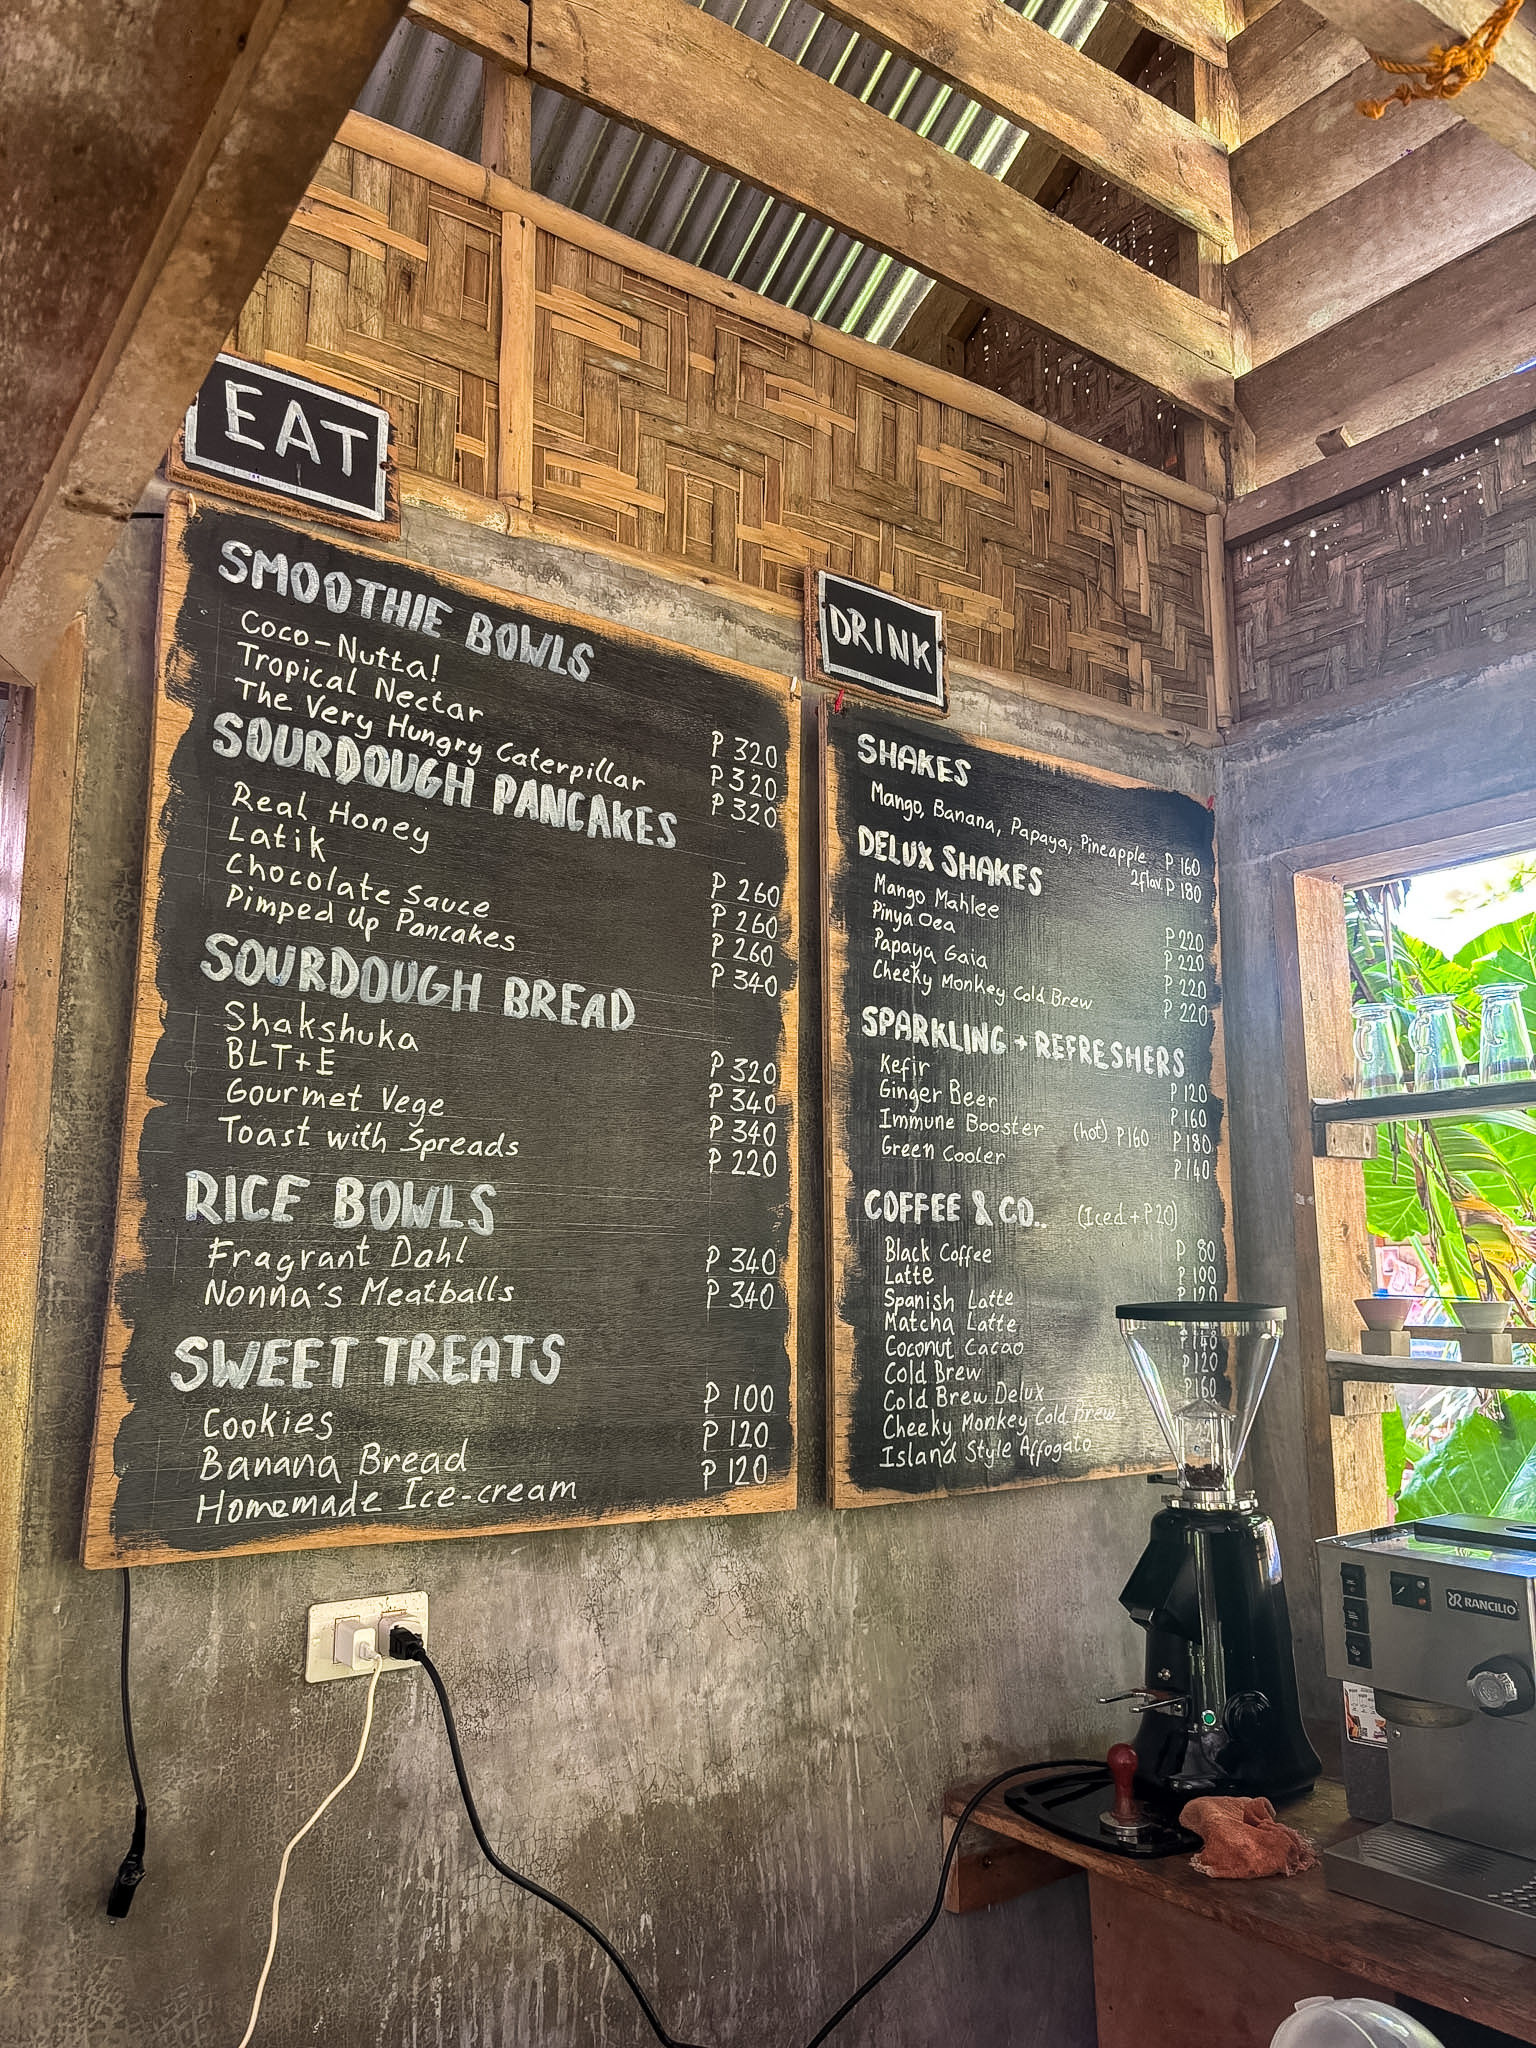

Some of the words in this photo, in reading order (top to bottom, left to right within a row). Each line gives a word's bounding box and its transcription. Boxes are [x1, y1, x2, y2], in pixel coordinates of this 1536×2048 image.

[225, 380, 368, 476] EAT
[219, 540, 453, 638] SMOOTHIE
[465, 612, 595, 682] BOWLS
[829, 604, 933, 674] DRINK
[237, 642, 357, 695] Tropical
[375, 677, 484, 721] Nectar
[234, 677, 292, 711] The
[307, 695, 373, 739] Very
[388, 714, 483, 766] Hungry
[497, 743, 646, 792] Caterpillar
[735, 738, 778, 768] 320
[857, 733, 972, 787] SHAKES
[213, 712, 475, 807] SOURDOUGH
[492, 773, 678, 848] PANCAKES
[729, 768, 777, 800] 320
[231, 781, 307, 820] Real
[329, 801, 430, 854] Honey
[731, 799, 777, 828] 320
[871, 781, 924, 822] Mango,
[934, 799, 1000, 837] Banana,
[1011, 817, 1072, 854] Papaya,
[1081, 834, 1147, 868] Pineapple
[1181, 857, 1200, 876] 160
[229, 816, 326, 862] Latik
[858, 825, 934, 872] DELUX
[942, 845, 1043, 896] SHAKES
[226, 853, 391, 905] Chocolate
[404, 885, 490, 918] Sauce
[738, 880, 780, 907] 260
[874, 873, 925, 910] Mango
[935, 888, 999, 918] Mahlee
[1181, 883, 1201, 903] 180
[226, 884, 333, 924] Pimped
[348, 907, 379, 942] Up
[396, 909, 516, 952] Pancakes
[736, 910, 778, 938] 260
[872, 900, 913, 932] Pinya
[734, 939, 772, 967] 260
[874, 927, 936, 968] Papaya
[944, 945, 988, 969] Gaia
[1178, 930, 1203, 952] 220
[1178, 954, 1204, 972] 220
[200, 932, 482, 1012] SOURDOUGH
[504, 976, 635, 1031] BREAD
[734, 972, 778, 996] 340
[873, 959, 932, 996] Cheeky
[942, 974, 1005, 1006] Monkey
[1013, 986, 1045, 1005] Cold
[1051, 988, 1092, 1010] Brew
[1179, 979, 1206, 999] 220
[224, 1001, 418, 1051] Shakshuka
[1179, 1005, 1207, 1026] 220
[862, 1006, 1007, 1054] SPARKLING
[1035, 1030, 1185, 1078] REFRESHERS
[730, 1058, 776, 1084] 320
[880, 1053, 930, 1082] Kefir
[226, 1077, 362, 1112] Gourmet
[382, 1085, 444, 1127] Vege
[730, 1089, 776, 1114] 340
[879, 1079, 942, 1113] Ginger
[950, 1079, 997, 1108] Beer
[1184, 1083, 1208, 1103] 120
[879, 1108, 954, 1131] Immune
[966, 1113, 1044, 1137] Booster
[1073, 1118, 1108, 1143] (hot)
[1184, 1109, 1207, 1128] 160
[218, 1115, 310, 1147] Toast
[328, 1121, 387, 1153] with
[400, 1128, 519, 1161] Spreads
[731, 1122, 776, 1147] 340
[1187, 1133, 1211, 1154] 180
[732, 1150, 776, 1177] 220
[881, 1135, 934, 1159] Green
[943, 1145, 1006, 1165] Cooler
[1187, 1159, 1209, 1182] 140
[185, 1170, 310, 1225] RICE
[333, 1177, 497, 1236] BOWLS
[864, 1189, 961, 1224] COFFEE
[972, 1190, 994, 1226] &
[208, 1234, 370, 1282] Fragrant
[391, 1235, 469, 1268] Dahl
[729, 1248, 776, 1275] 340
[885, 1236, 930, 1263] Black
[940, 1243, 992, 1267] Coffee
[1197, 1239, 1215, 1262] 80
[885, 1265, 934, 1285] Latte
[205, 1278, 342, 1309] Nonna's
[360, 1275, 515, 1306] Meatballs
[729, 1281, 774, 1310] 340
[884, 1285, 954, 1315] Spanish
[968, 1290, 1014, 1310] Latte
[885, 1311, 954, 1335] Matcha
[967, 1312, 1017, 1332] Latte
[885, 1335, 954, 1359] Coconut
[965, 1338, 1024, 1356] Cacao
[170, 1335, 359, 1393] SWEET
[376, 1333, 566, 1386] TREATS
[885, 1359, 928, 1385] Cold
[935, 1360, 982, 1383] Brew
[734, 1384, 773, 1412] 100
[883, 1387, 928, 1411] Cold
[936, 1385, 988, 1408] Brew
[995, 1381, 1044, 1403] Delux
[204, 1403, 334, 1441] Cookies
[730, 1420, 769, 1449] 120
[883, 1409, 951, 1446] Cheeky
[962, 1407, 1028, 1435] Monkey
[1036, 1404, 1069, 1425] Cold
[200, 1445, 341, 1484] Banana
[359, 1438, 467, 1474] Bread
[879, 1441, 956, 1468] Island
[965, 1440, 1012, 1469] Style
[1020, 1432, 1091, 1466] Affogato
[729, 1455, 767, 1485] 120
[197, 1480, 382, 1525] Homemade
[398, 1476, 577, 1510] Ice-cream
[1464, 1597, 1516, 1615] RANCILIO
